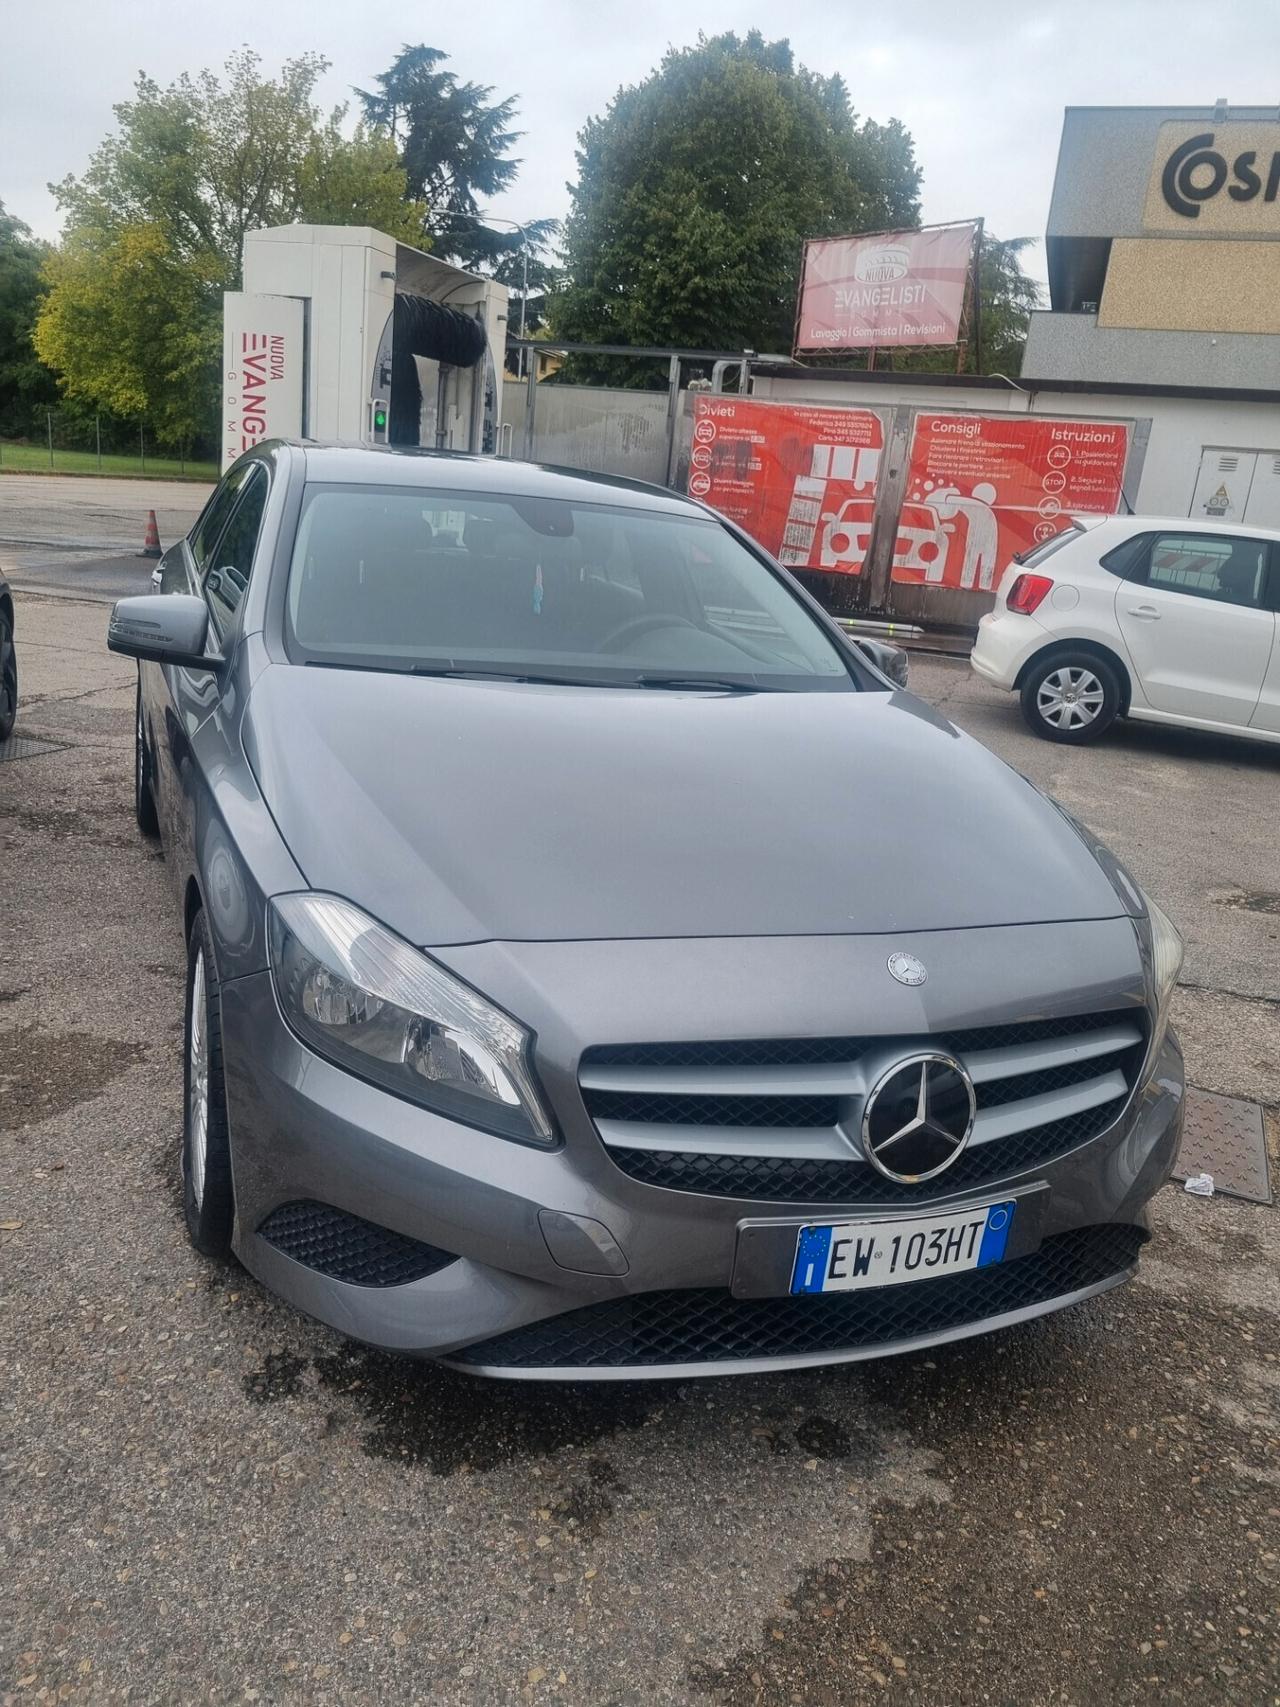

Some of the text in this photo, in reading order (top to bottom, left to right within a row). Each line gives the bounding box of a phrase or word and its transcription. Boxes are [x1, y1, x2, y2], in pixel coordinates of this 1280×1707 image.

[865, 267, 895, 282] NUOVA
[834, 285, 927, 308] EVANGELISTI
[811, 322, 946, 341] Lavaggio Gommista Revisioni
[270, 335, 285, 380] NUOVA
[699, 404, 735, 417] Divieti
[931, 421, 981, 439] Consigli
[1051, 428, 1115, 444] Istruzioni
[828, 1220, 985, 1280] EW 103HT
